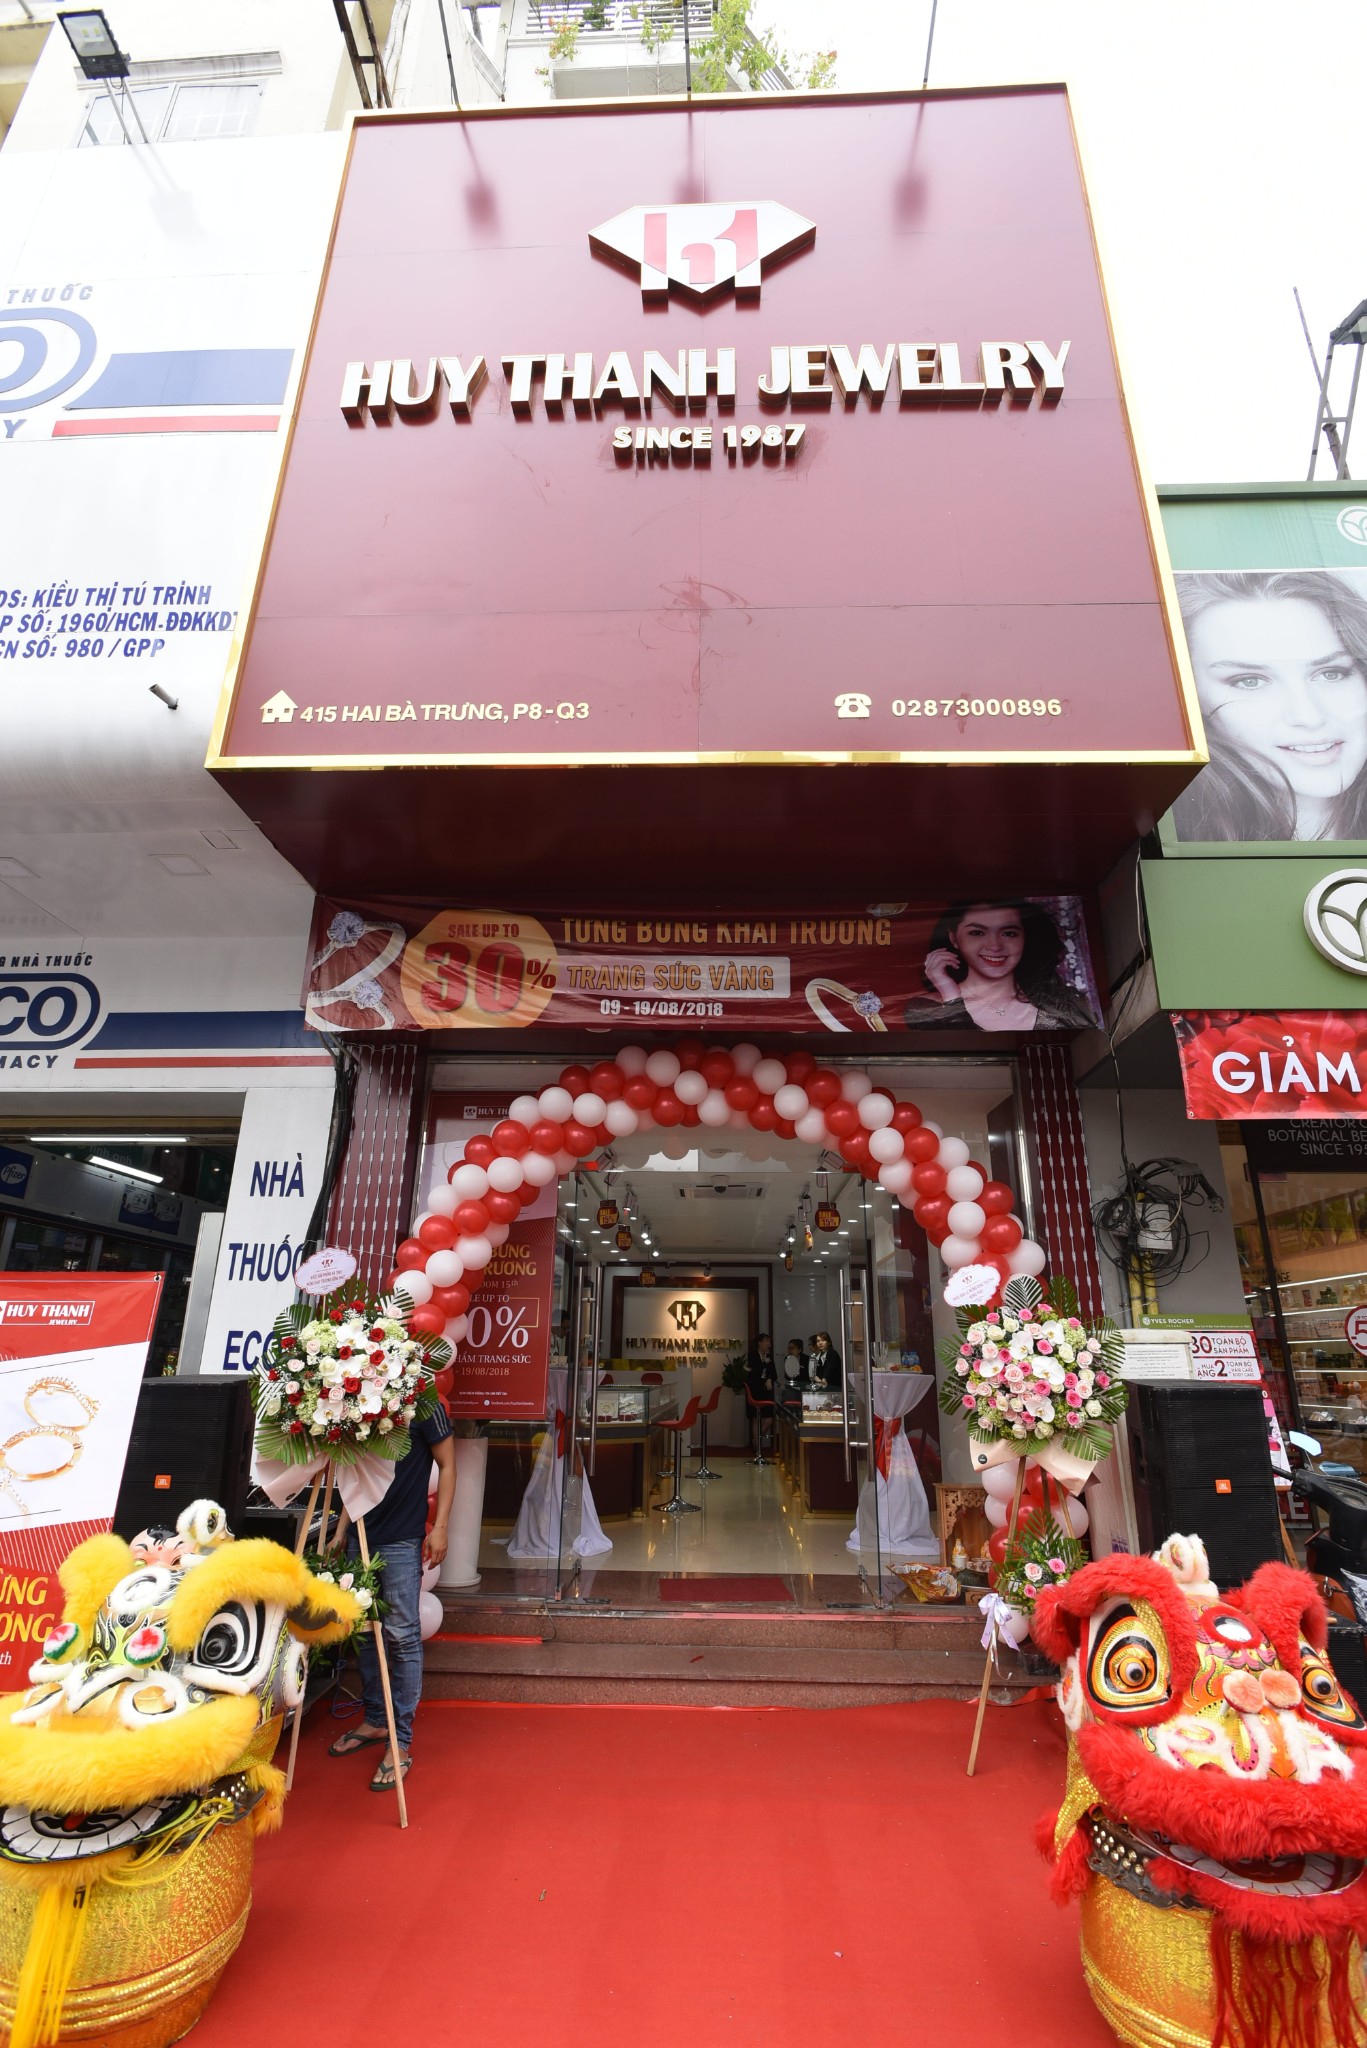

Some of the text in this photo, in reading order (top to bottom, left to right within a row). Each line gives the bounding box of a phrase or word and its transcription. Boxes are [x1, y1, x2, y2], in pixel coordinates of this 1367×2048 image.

[340, 340, 1071, 415] HUY THANH JEWELRY
[612, 423, 806, 453] SINCE 1987
[122, 581, 147, 606] TÚ
[17, 609, 52, 633] SỐ:
[22, 632, 57, 659] SỐ:
[65, 638, 104, 658] 980
[123, 638, 166, 658] GPP
[300, 706, 337, 723] 415
[342, 705, 381, 722] HAI
[385, 701, 417, 722] BÀ
[891, 698, 1063, 717] 02873000896
[448, 923, 520, 938] SALE UP TO
[11, 952, 41, 967] NHÀ
[46, 951, 94, 967] THUỐC
[421, 941, 557, 1014] 30%
[567, 960, 774, 991] TRANG SỨC VÀNG
[600, 1000, 621, 1016] 09
[633, 1000, 724, 1017] 19/08/2018
[1212, 1035, 1362, 1094] GIẢM
[1290, 1119, 1357, 1129] CREATOR
[1267, 1129, 1349, 1142] BOTANICAL
[1300, 1143, 1344, 1155] SINCE
[3, 1165, 26, 1183] Pfizer
[250, 1152, 304, 1197] NHÀ
[482, 1294, 496, 1303] UP
[497, 1294, 510, 1303] TO
[6, 1304, 90, 1318] HUY THANH
[625, 1337, 649, 1349] HUY
[651, 1337, 691, 1353] THANH
[478, 1354, 510, 1364] TRANG
[511, 1353, 531, 1364] SỨC
[461, 1367, 510, 1376] 19/08/2018
